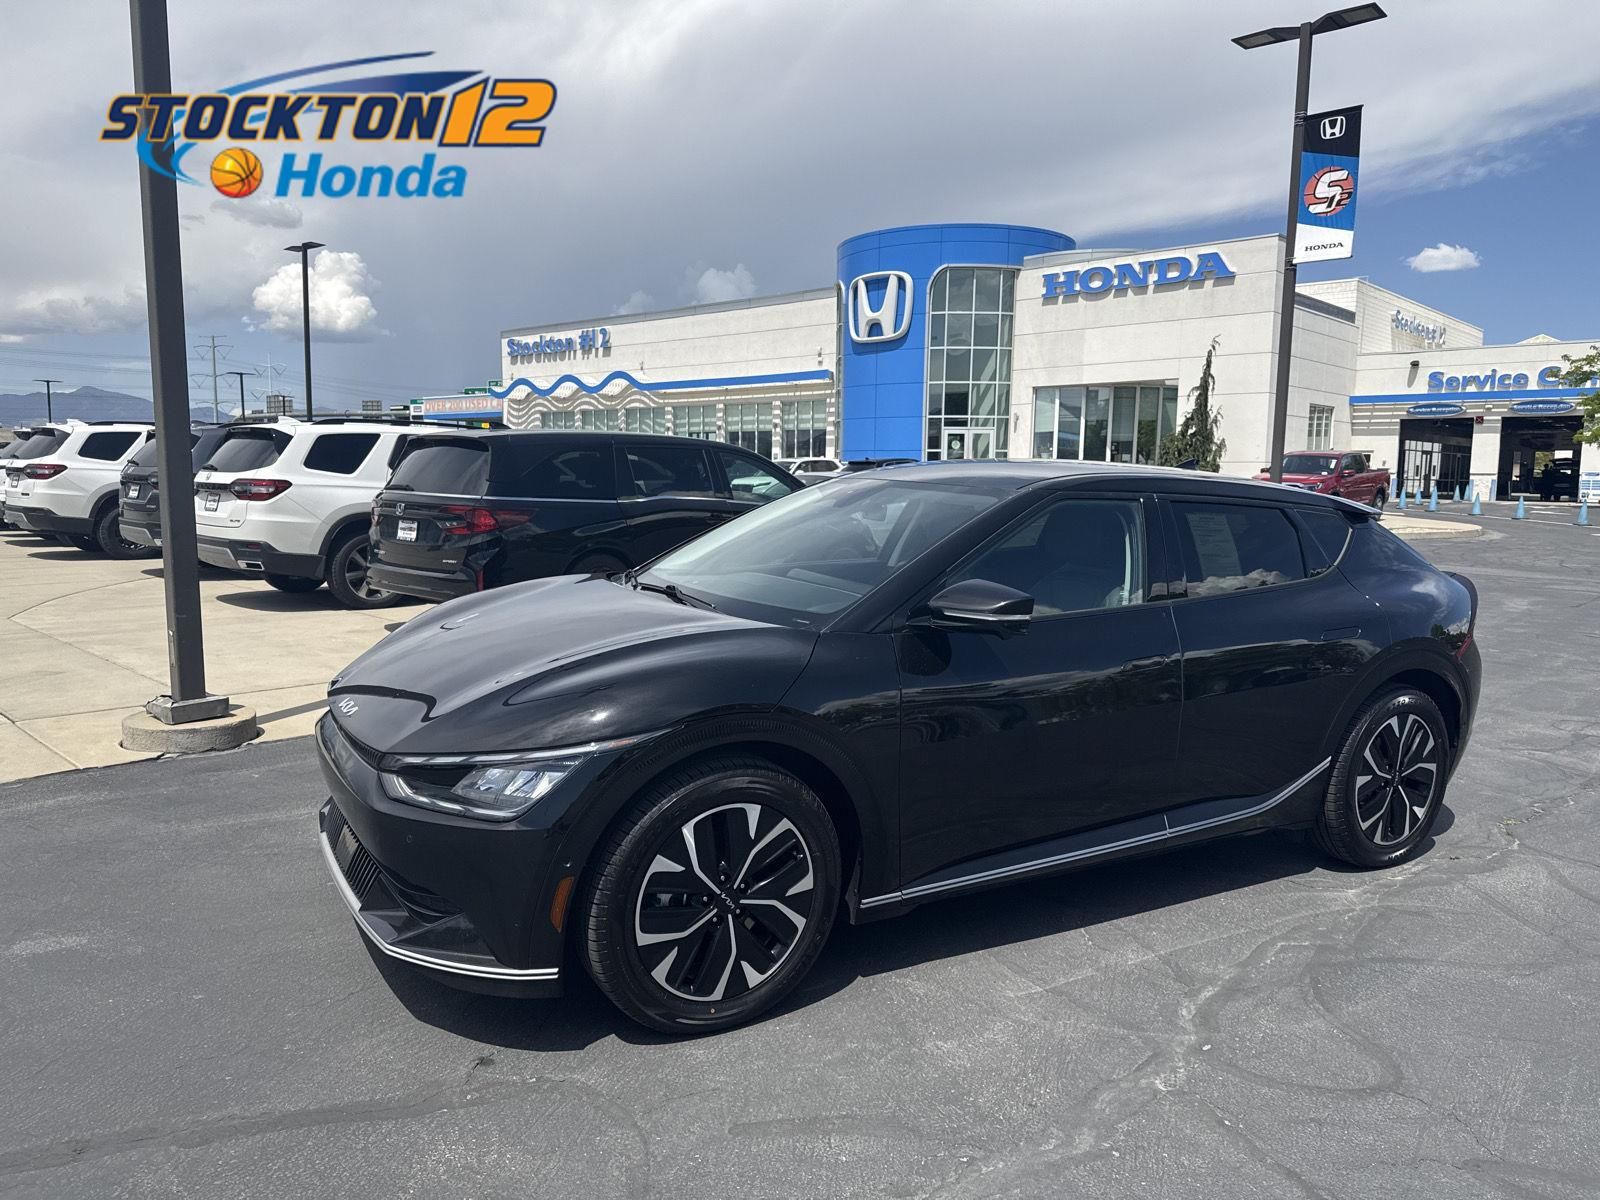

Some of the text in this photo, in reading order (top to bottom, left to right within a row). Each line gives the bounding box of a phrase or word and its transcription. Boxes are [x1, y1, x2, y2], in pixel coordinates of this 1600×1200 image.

[1304, 242, 1344, 252] HONDA
[1042, 252, 1237, 298] HONDA
[507, 327, 610, 356] Stockton #12
[1428, 368, 1529, 391] Service
[424, 399, 447, 411] OVER
[447, 399, 464, 410] 200
[465, 397, 488, 409] USED
